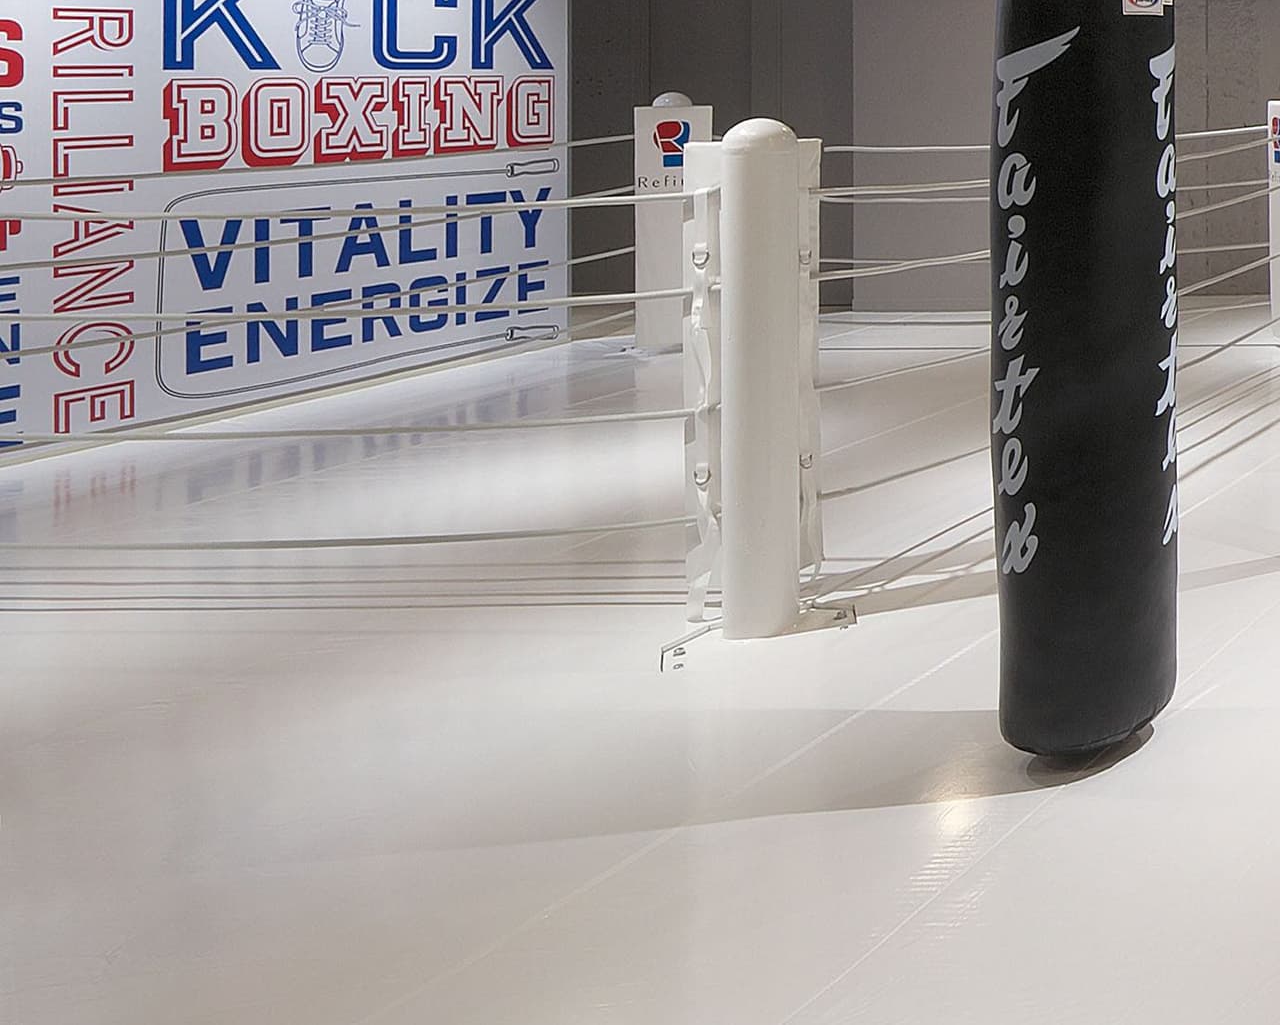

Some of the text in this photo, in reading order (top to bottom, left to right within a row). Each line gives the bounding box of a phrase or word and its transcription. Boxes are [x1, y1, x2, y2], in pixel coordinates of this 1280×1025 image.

[163, 76, 554, 172] BOXING
[180, 187, 552, 291] VITALITY
[186, 260, 549, 375] ENERGIZE
